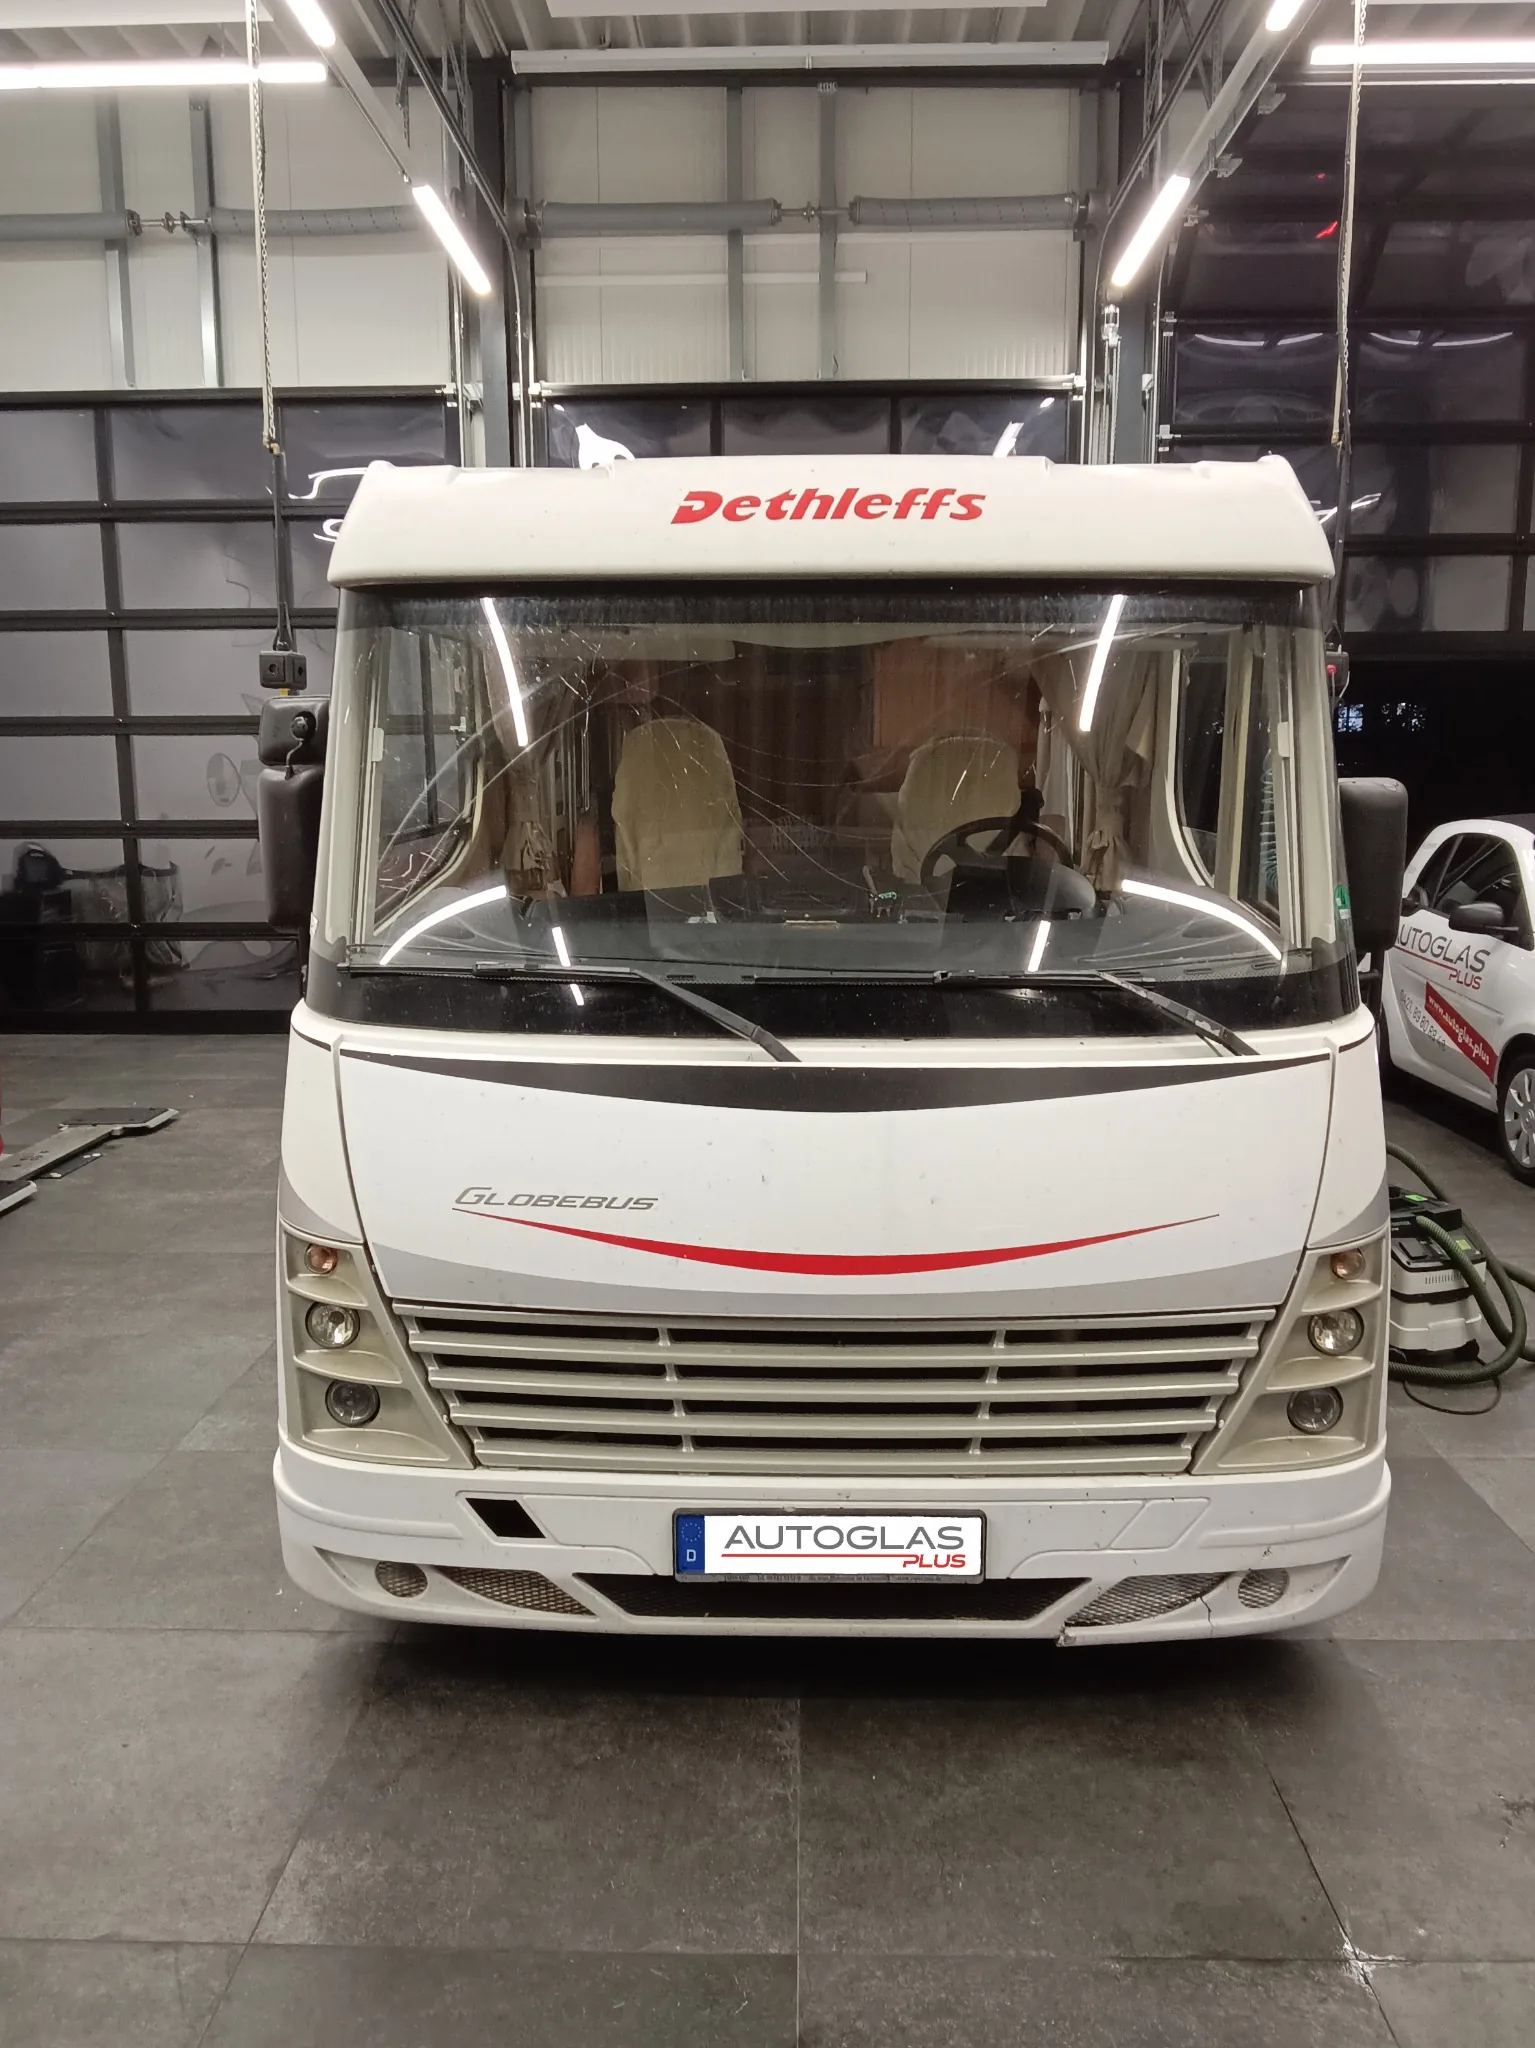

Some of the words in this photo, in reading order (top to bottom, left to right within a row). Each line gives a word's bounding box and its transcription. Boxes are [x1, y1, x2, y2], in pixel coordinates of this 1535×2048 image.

[670, 488, 987, 525] Dethleffs
[1395, 924, 1491, 973] UTOGLAS
[1448, 969, 1482, 990] PLUS
[1428, 995, 1490, 1066] www.autoglas.plus
[454, 1186, 659, 1211] GLOBEBUS
[686, 1549, 697, 1562] D
